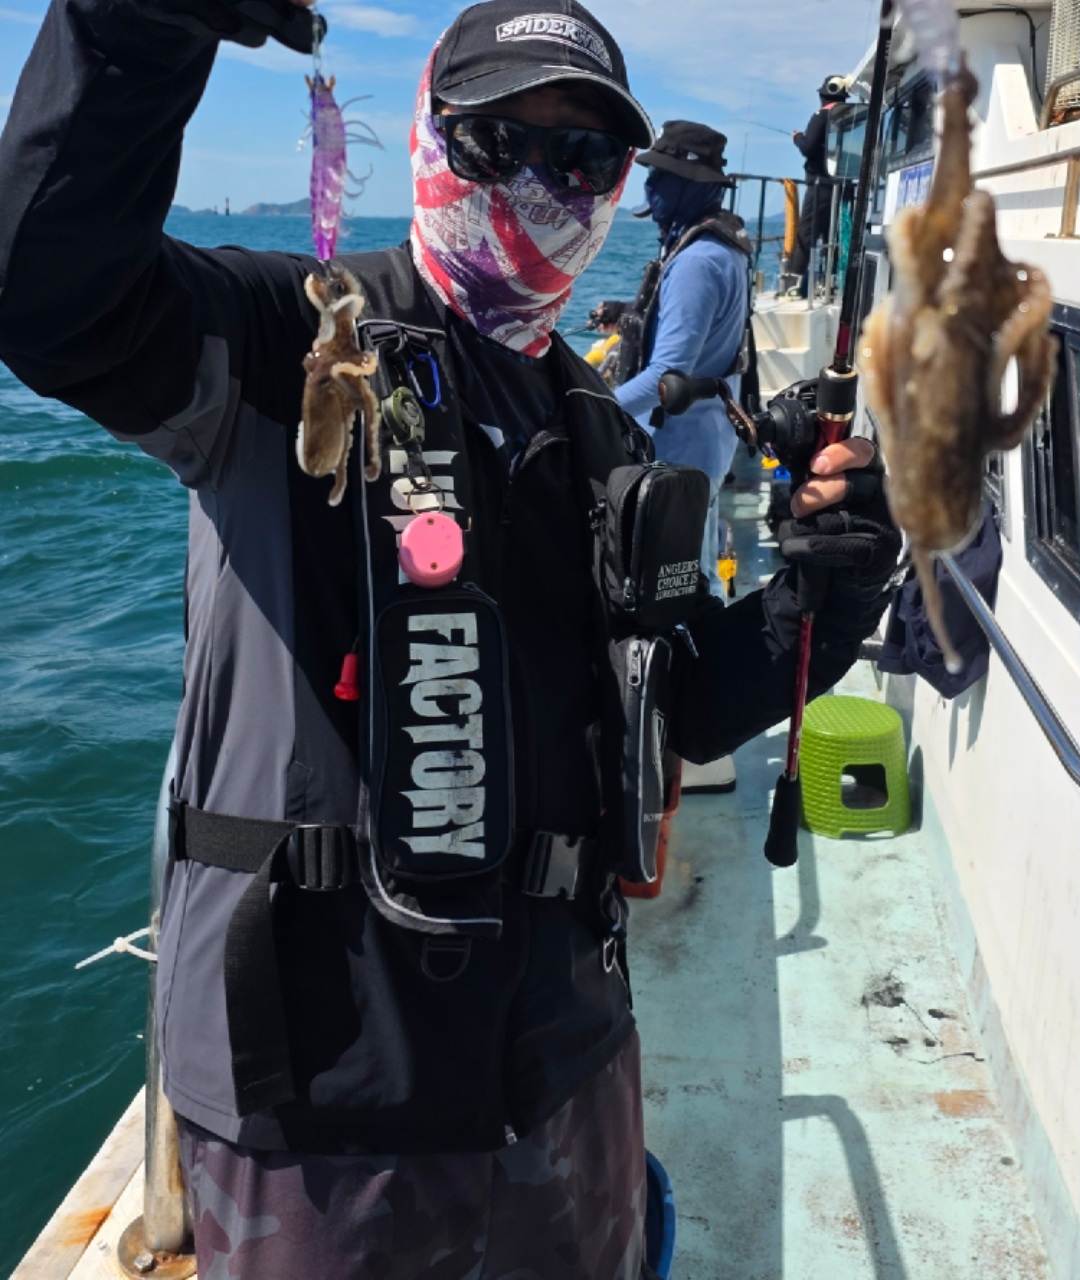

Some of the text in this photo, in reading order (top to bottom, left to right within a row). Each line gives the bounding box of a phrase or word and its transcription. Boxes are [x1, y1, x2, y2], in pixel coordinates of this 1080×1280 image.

[658, 559, 699, 578] ANGLER'S
[658, 572, 698, 591] CHOICE IS
[399, 612, 487, 860] FACTORY
